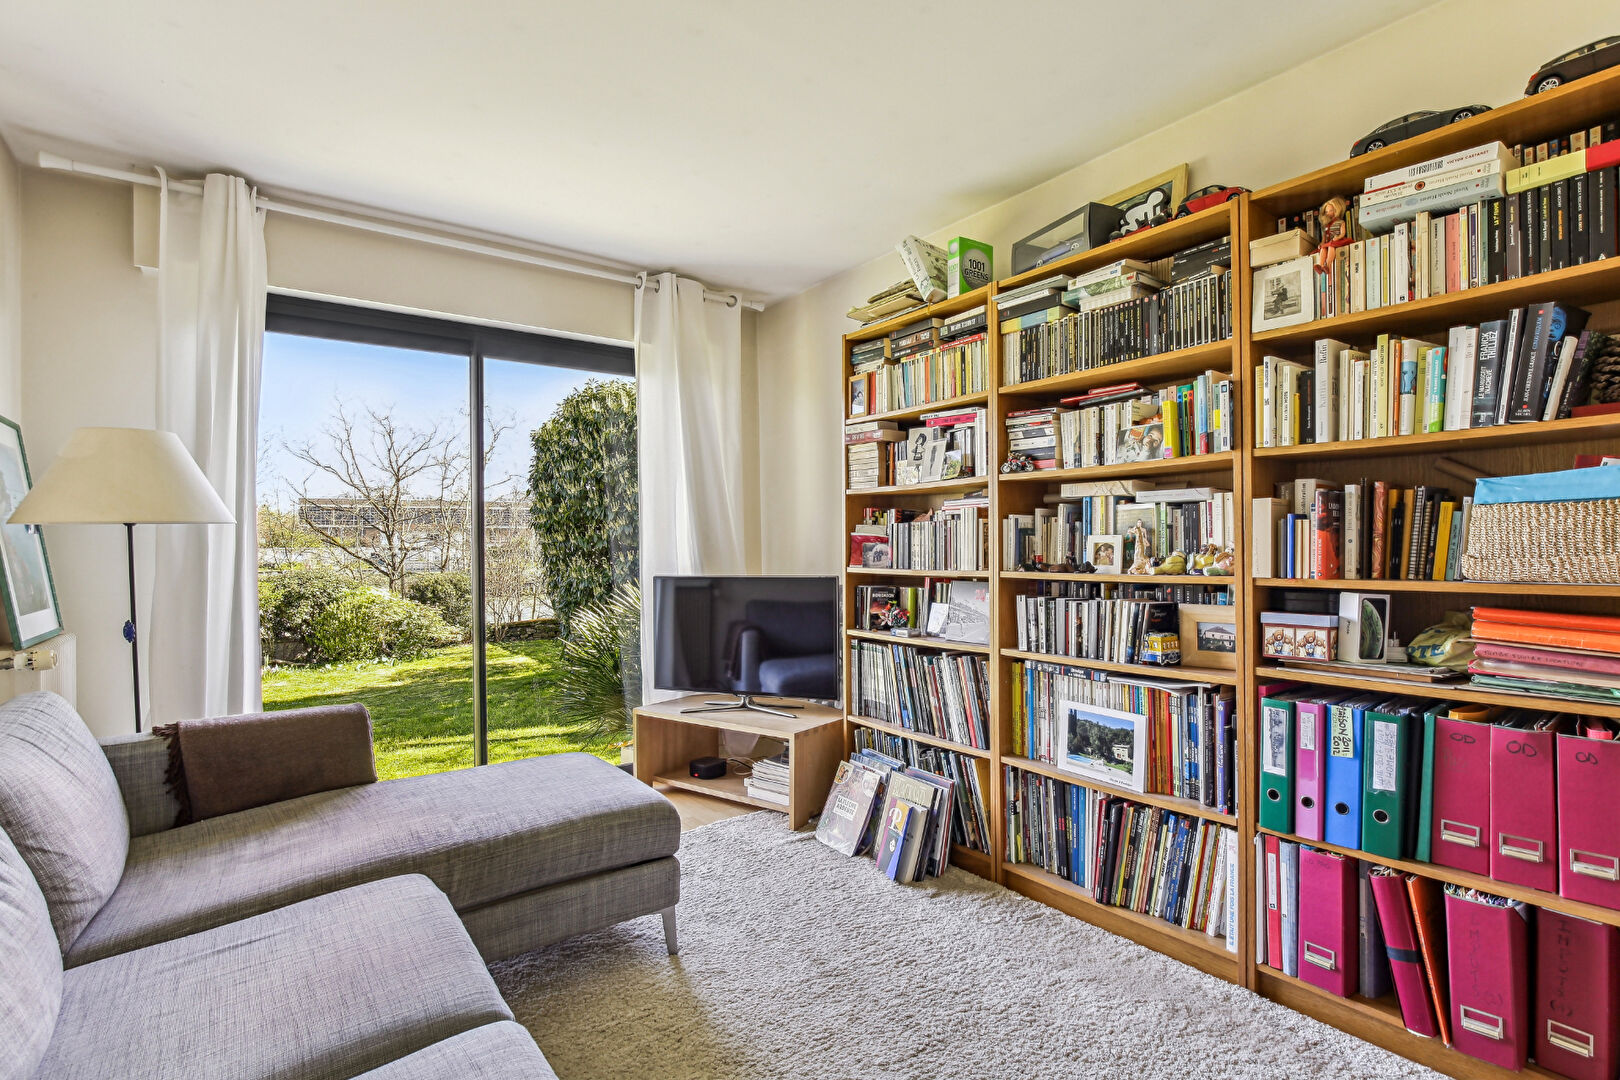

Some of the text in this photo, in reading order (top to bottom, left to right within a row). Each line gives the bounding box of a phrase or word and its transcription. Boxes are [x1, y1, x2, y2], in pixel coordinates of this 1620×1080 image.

[968, 258, 986, 272] 1001
[964, 268, 989, 281] GREENS
[1480, 332, 1489, 360] FRANCK
[1487, 330, 1498, 360] THILLIEZ
[1332, 735, 1341, 755] 2012
[1341, 736, 1352, 753] 2011
